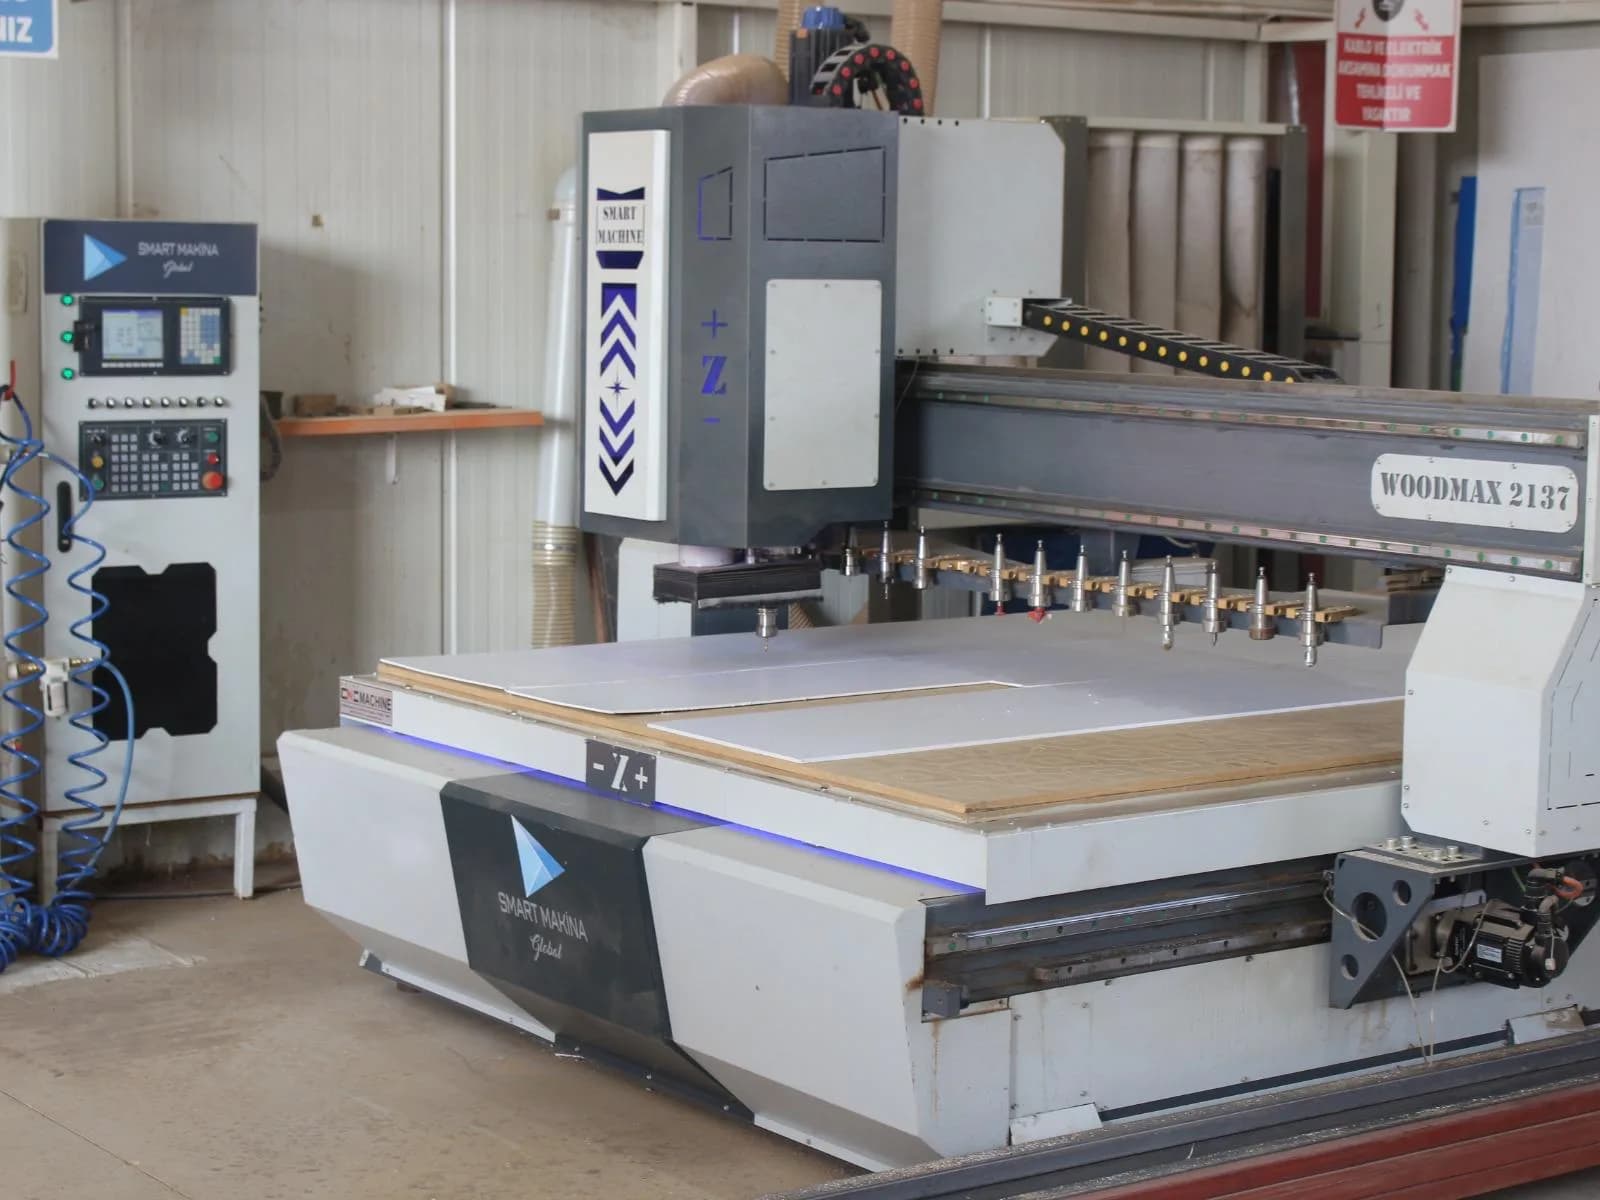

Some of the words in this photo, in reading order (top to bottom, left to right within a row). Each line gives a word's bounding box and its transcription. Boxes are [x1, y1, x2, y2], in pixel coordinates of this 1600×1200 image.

[603, 206, 638, 221] SMART
[138, 241, 176, 256] SMART
[597, 229, 644, 244] MACHINE
[702, 355, 728, 394] Z
[1380, 471, 1504, 507] WOODMAX
[1509, 482, 1571, 512] 2137
[498, 891, 538, 924] SMART
